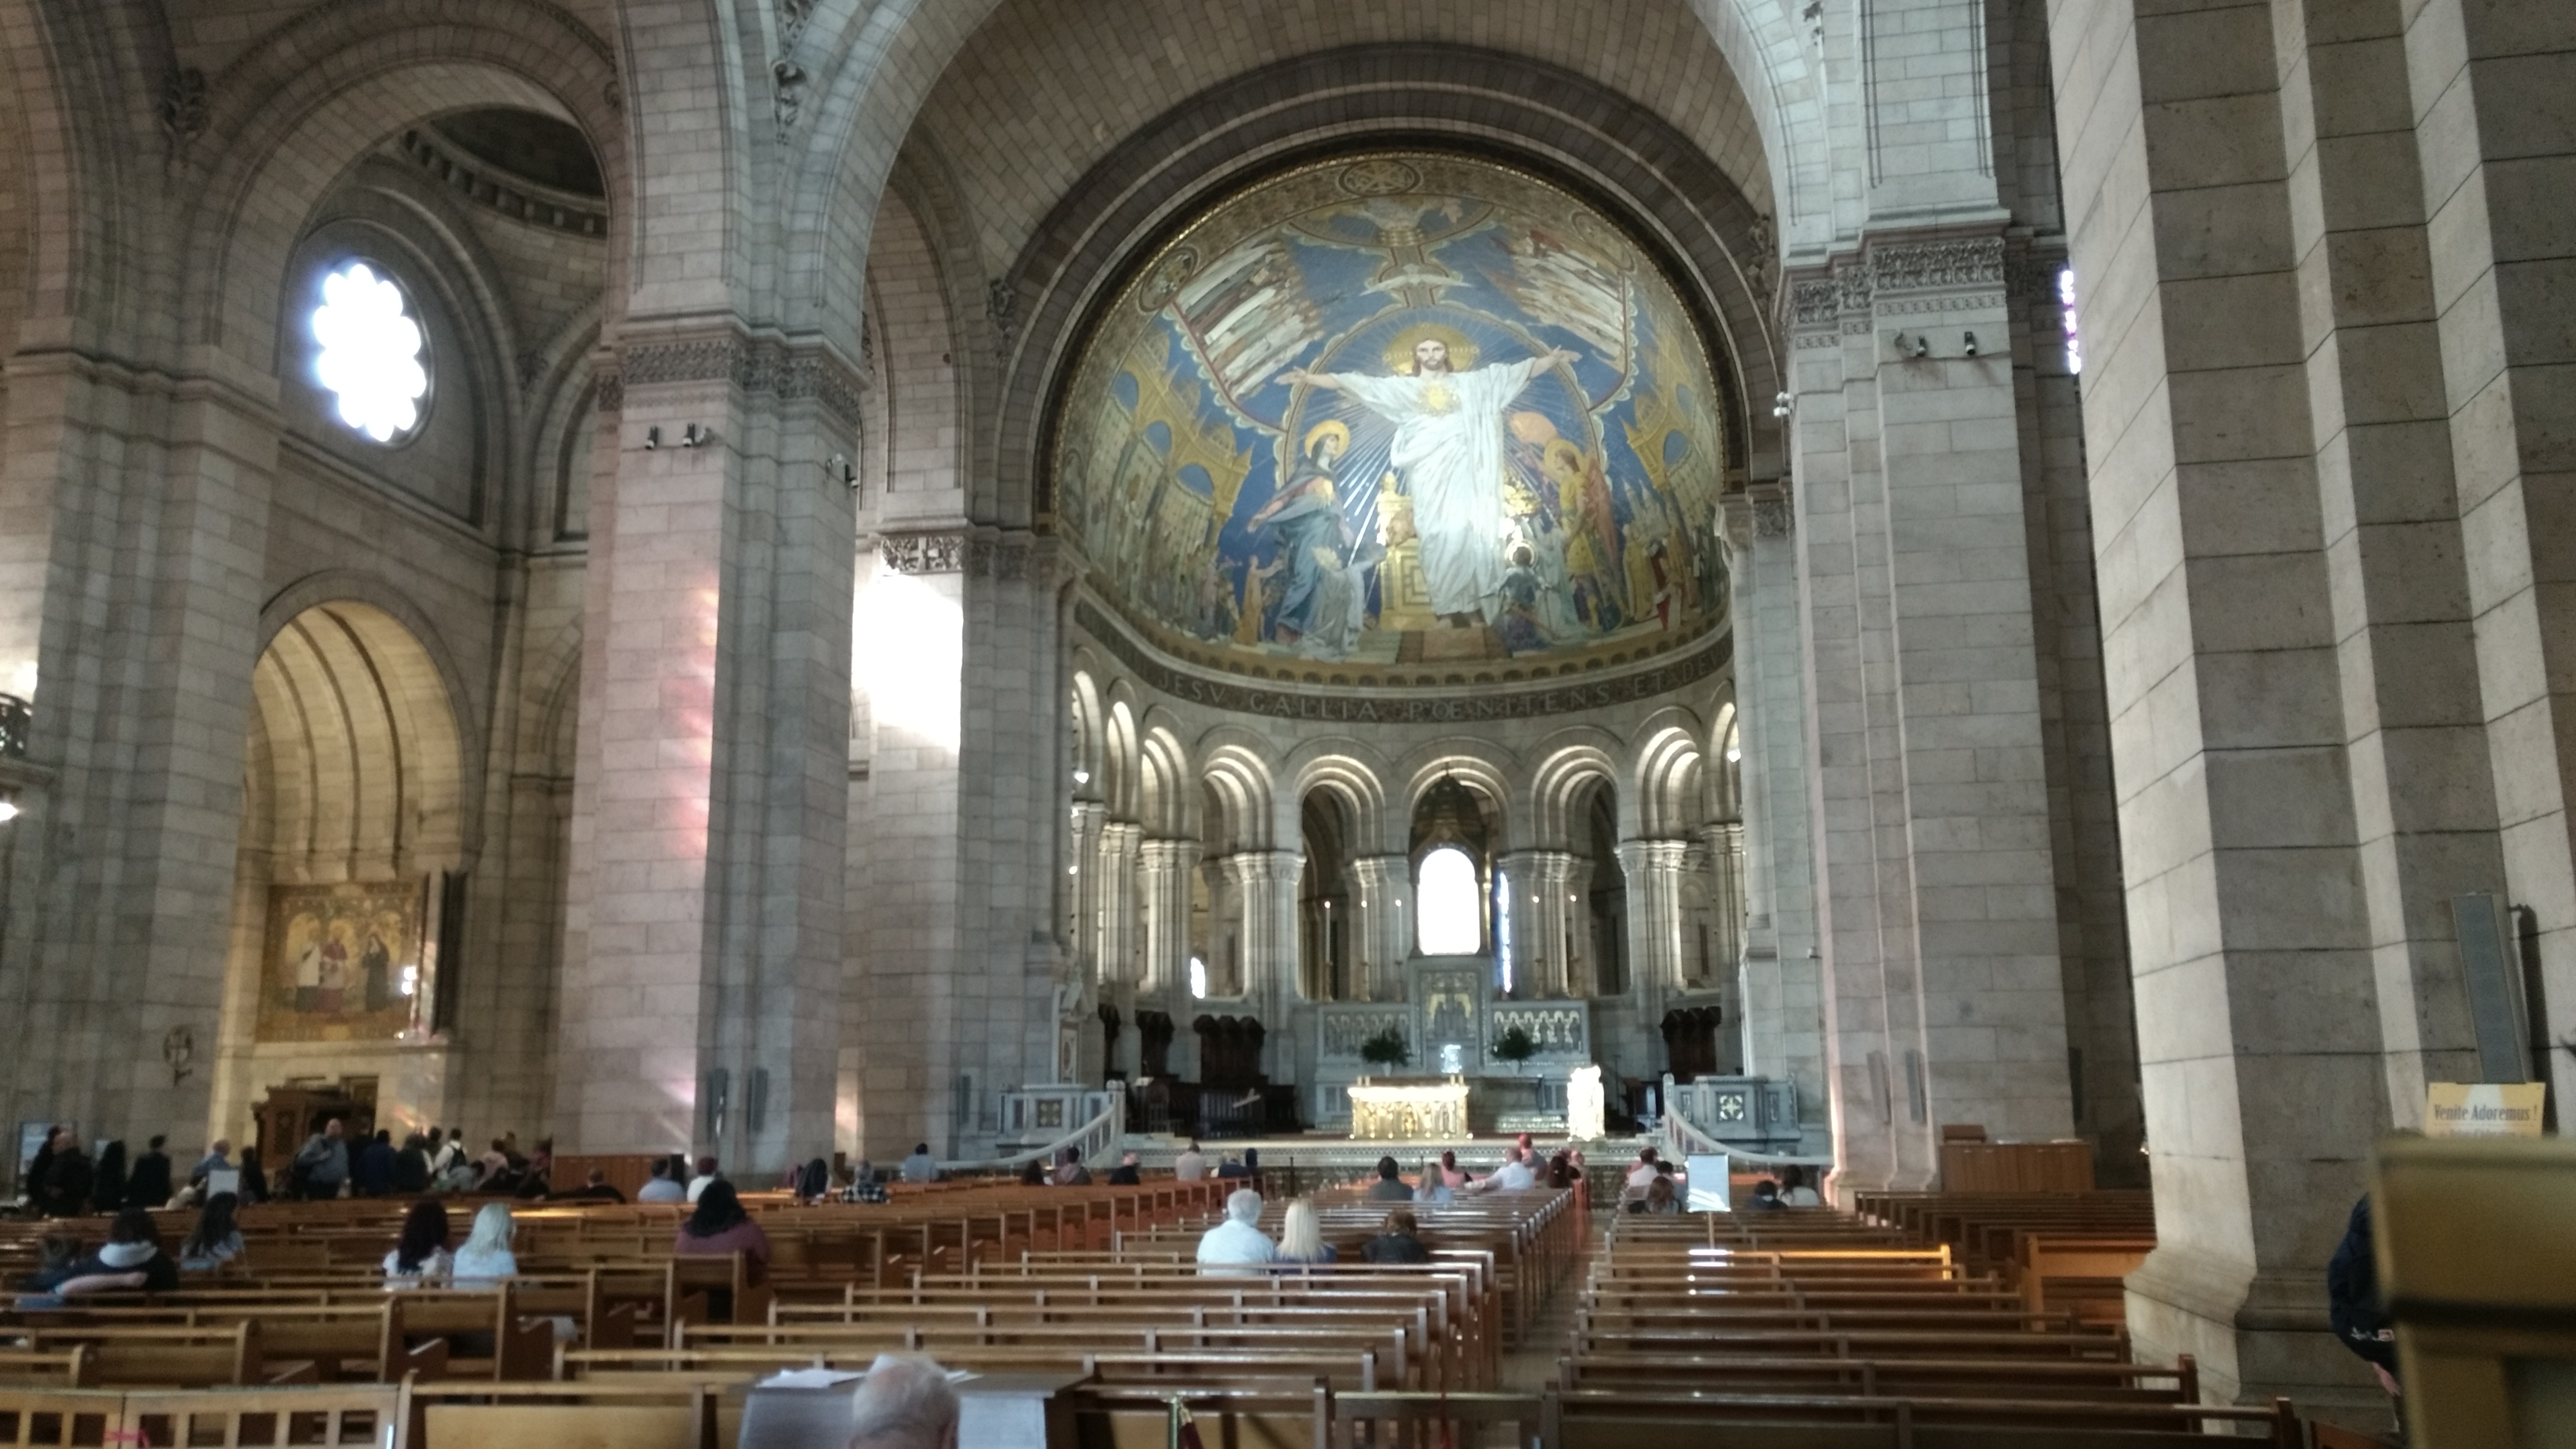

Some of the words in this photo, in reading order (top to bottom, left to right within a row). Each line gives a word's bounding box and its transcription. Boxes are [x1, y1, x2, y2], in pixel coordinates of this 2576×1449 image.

[1634, 671, 1666, 697] ET
[2434, 1104, 2468, 1121] Venite
[2470, 1104, 2530, 1121] Adoremus
